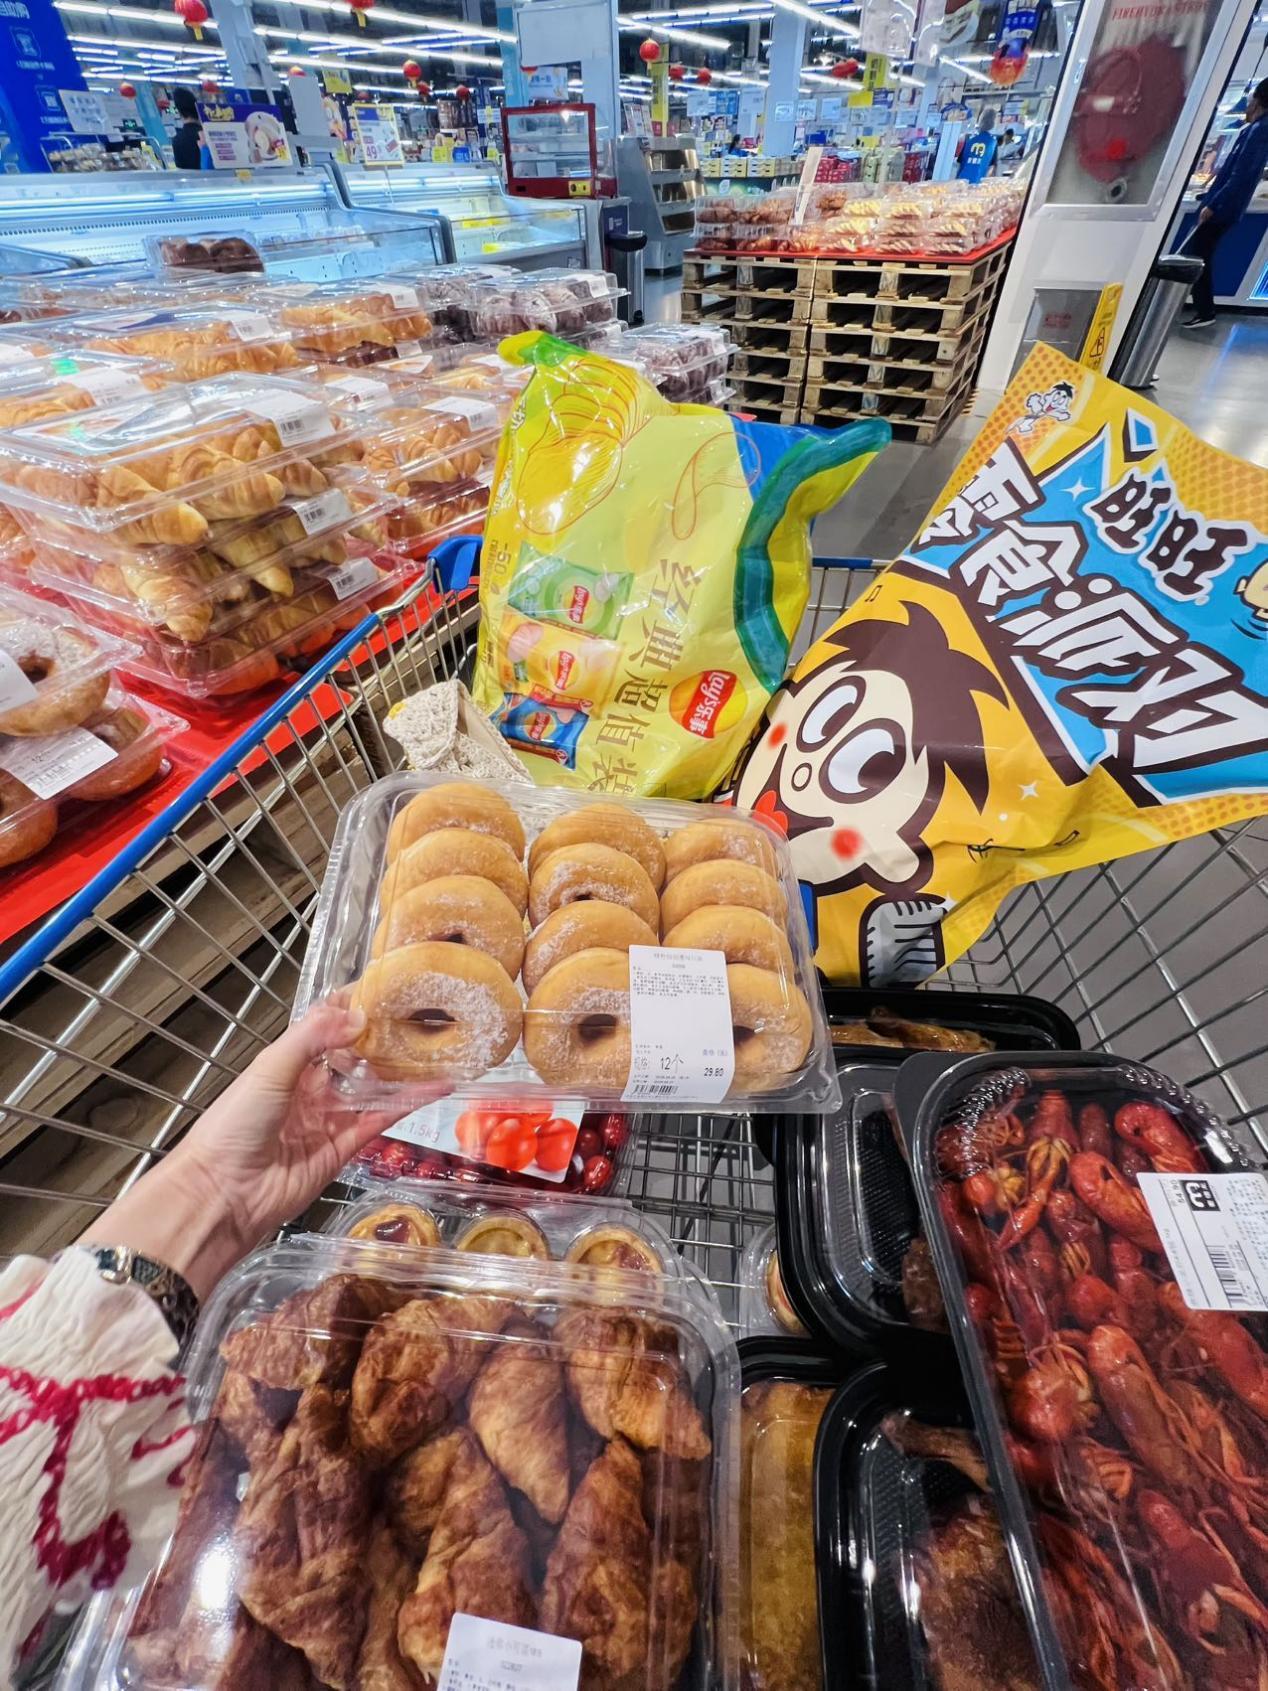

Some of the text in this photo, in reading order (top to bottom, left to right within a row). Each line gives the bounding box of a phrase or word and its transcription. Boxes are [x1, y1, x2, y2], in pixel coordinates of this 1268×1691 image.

[1090, 473, 1247, 595] 旺旺
[588, 558, 702, 797] 经典超值装
[692, 706, 721, 734] 乐事
